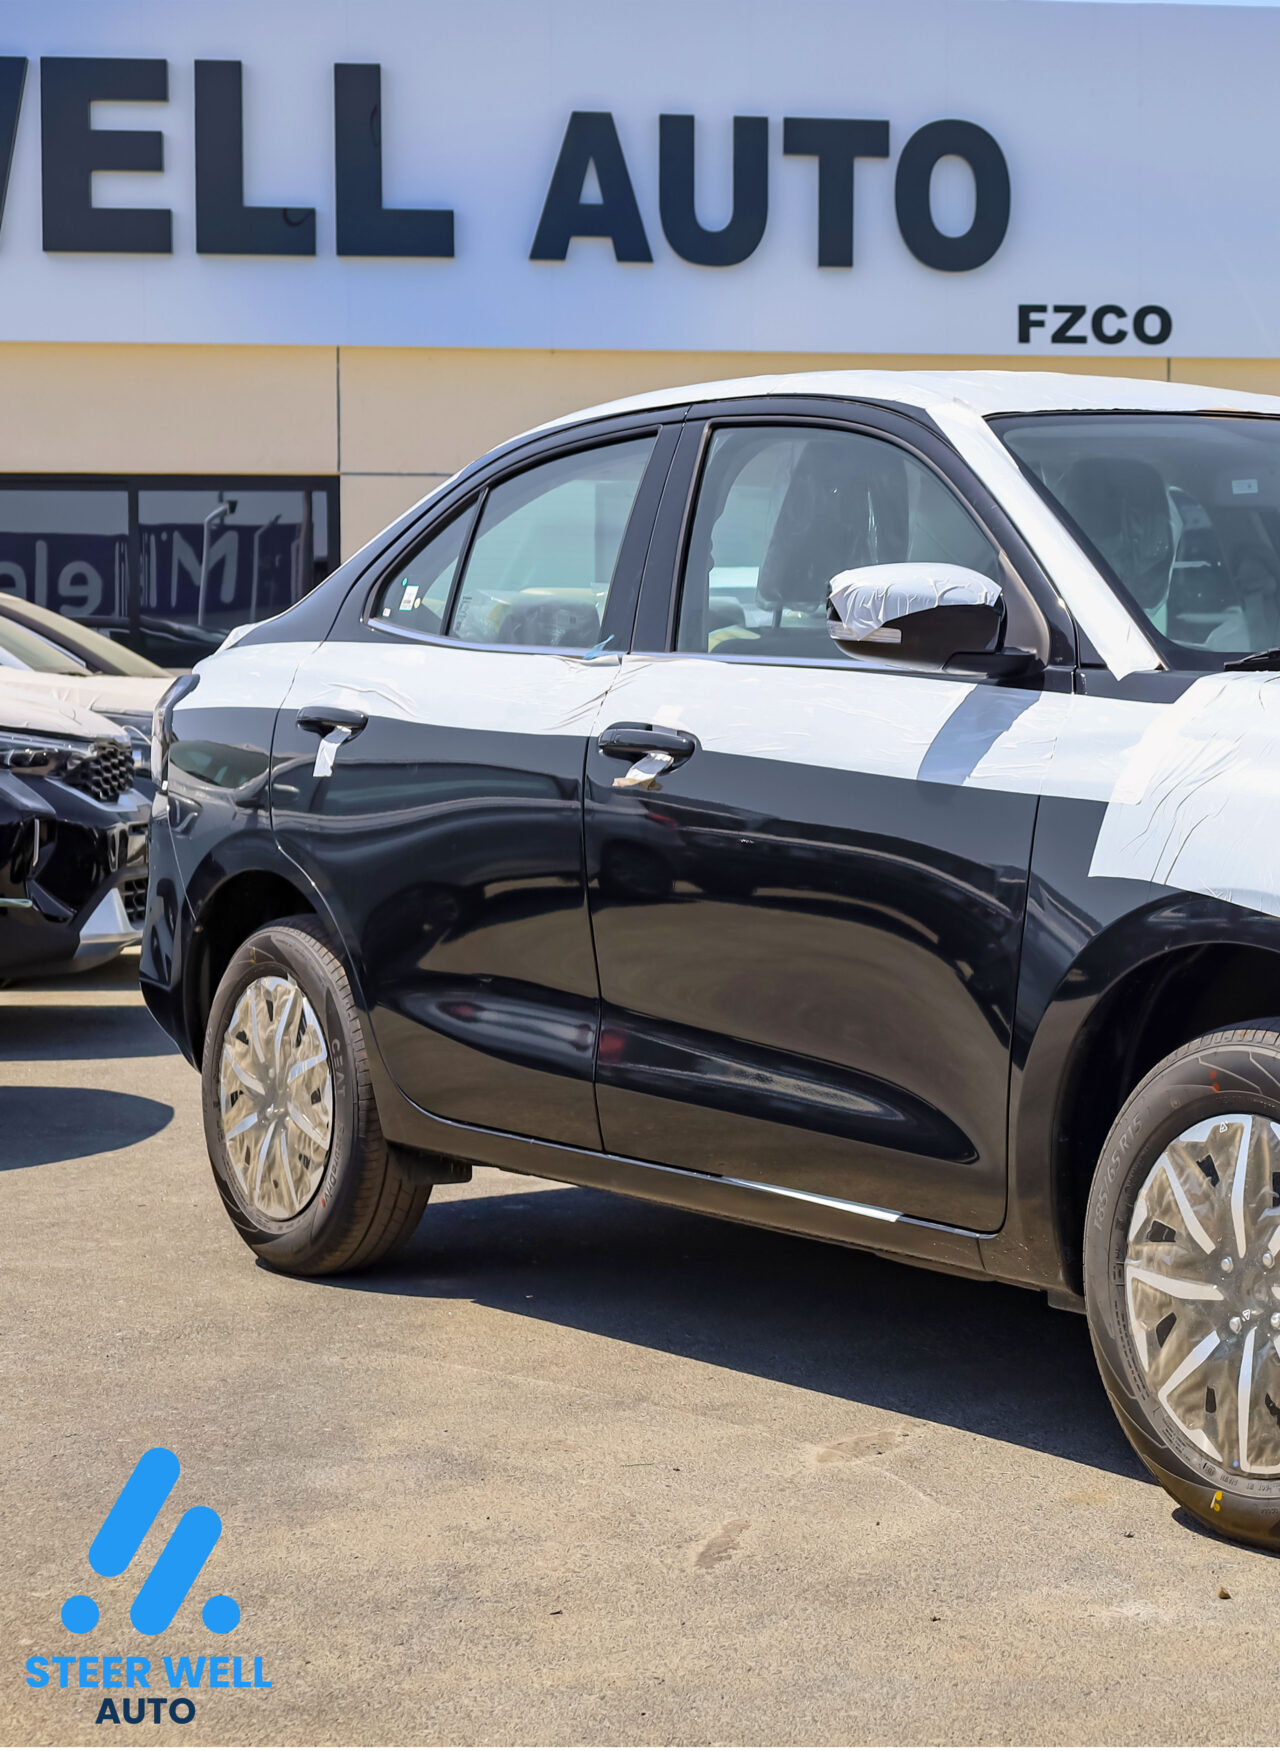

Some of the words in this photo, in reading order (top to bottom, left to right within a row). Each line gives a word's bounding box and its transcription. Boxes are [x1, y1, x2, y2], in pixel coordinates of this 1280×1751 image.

[0, 56, 455, 258] ELL
[530, 111, 1011, 272] AUTO
[1018, 304, 1173, 346] FZCO
[331, 1038, 346, 1097] CEAT
